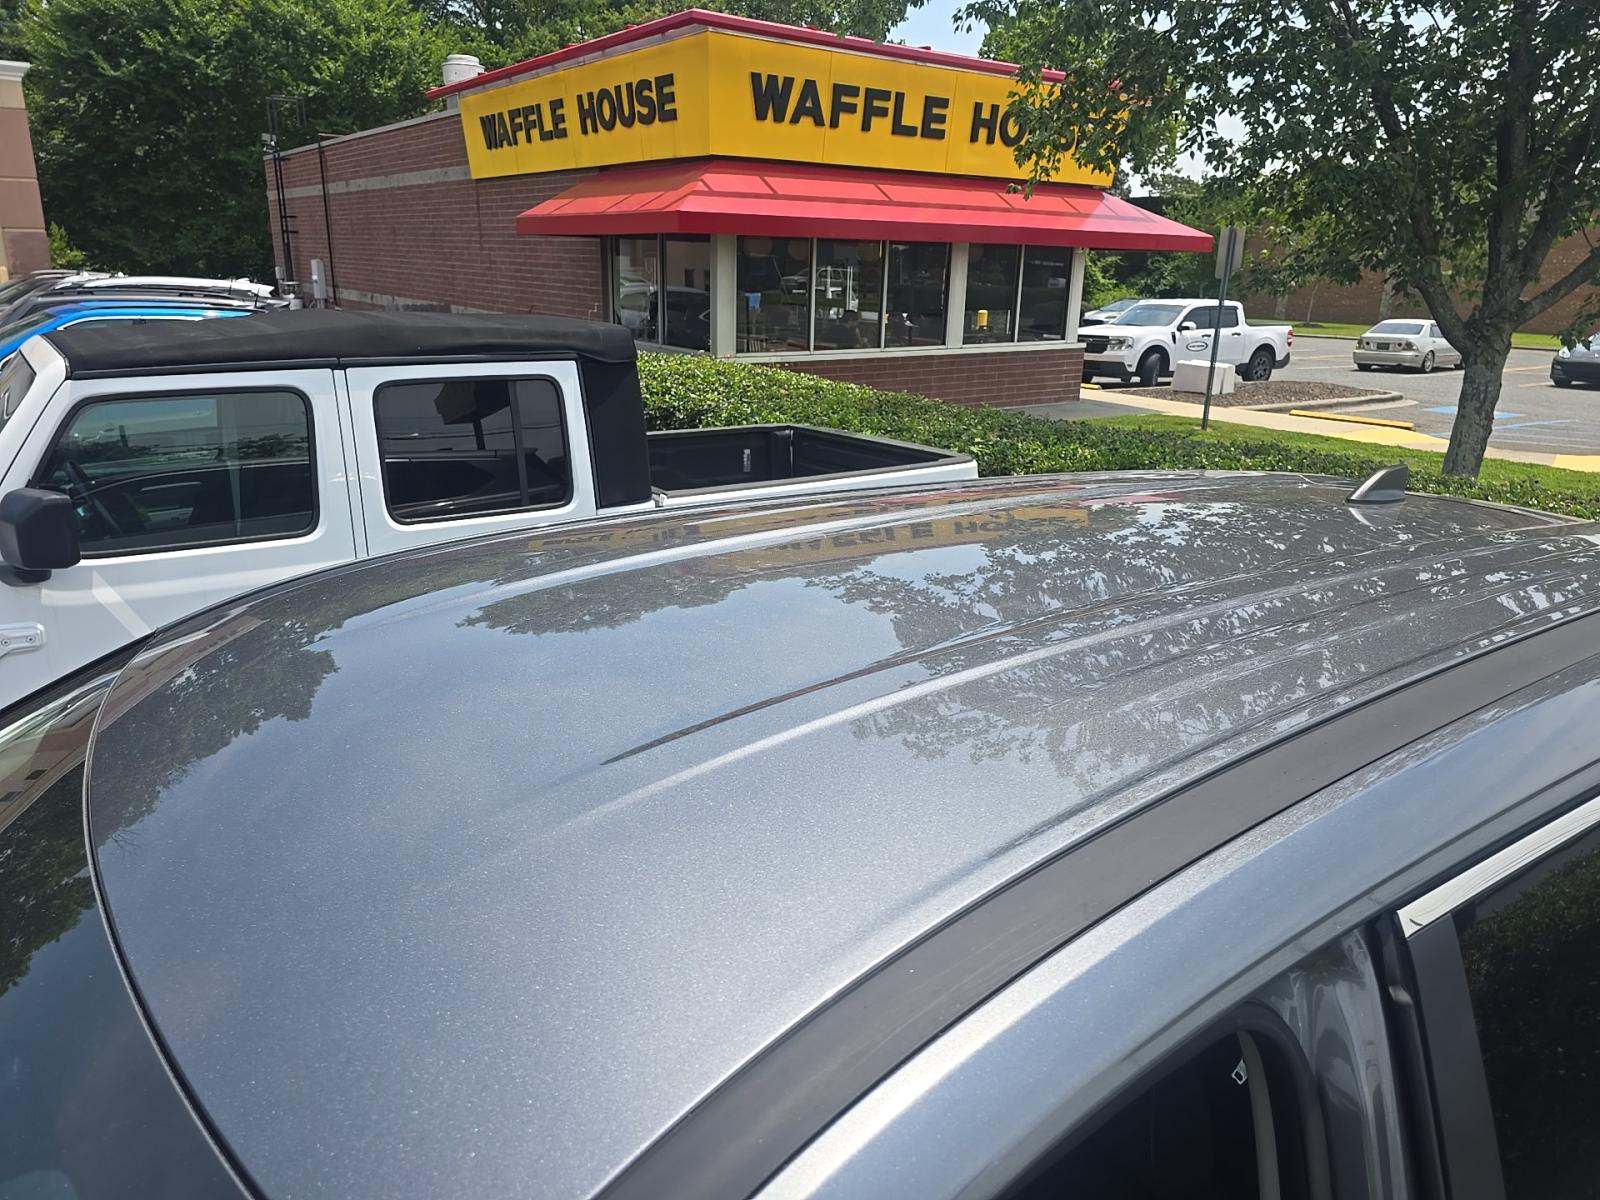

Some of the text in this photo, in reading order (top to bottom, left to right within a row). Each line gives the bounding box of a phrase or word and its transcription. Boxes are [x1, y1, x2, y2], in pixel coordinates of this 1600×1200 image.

[479, 73, 677, 151] WAFFLE HOUSE
[750, 71, 950, 140] WAFFLE
